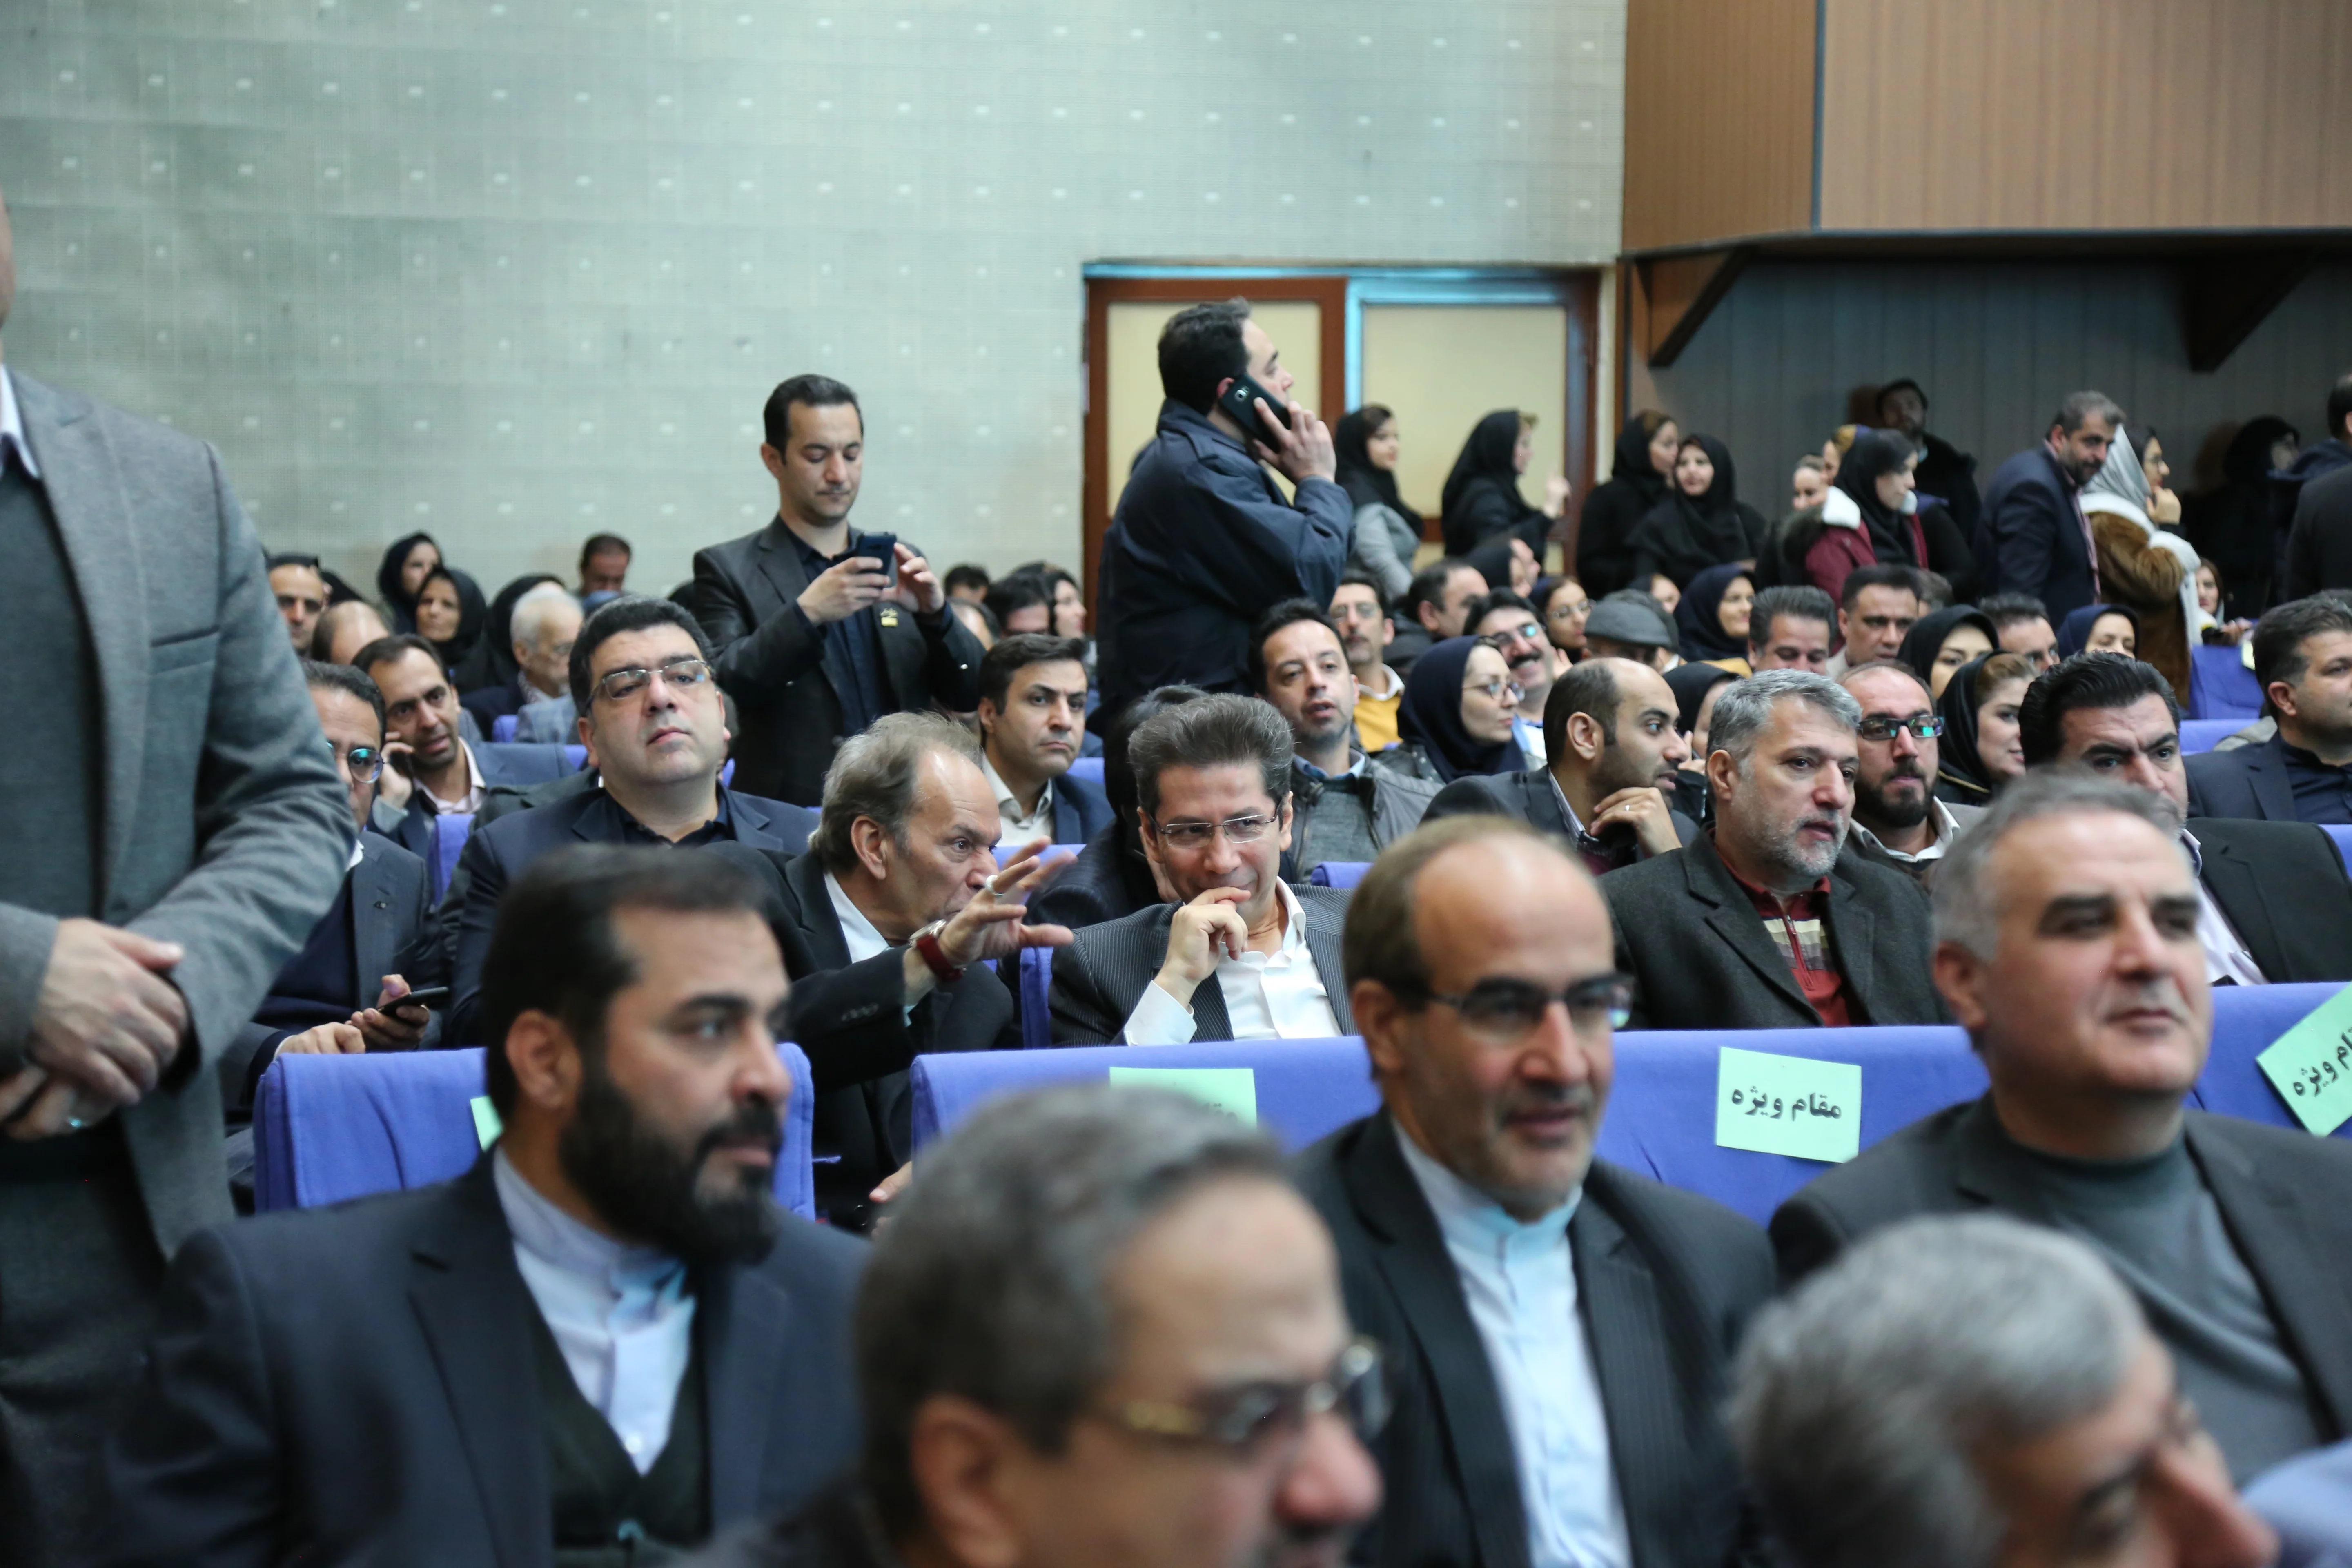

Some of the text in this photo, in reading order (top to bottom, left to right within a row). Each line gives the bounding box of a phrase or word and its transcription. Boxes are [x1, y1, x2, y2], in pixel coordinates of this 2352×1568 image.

[2293, 1061, 2339, 1097] ویژه
[1732, 1086, 1842, 1121] مقام ویژه
